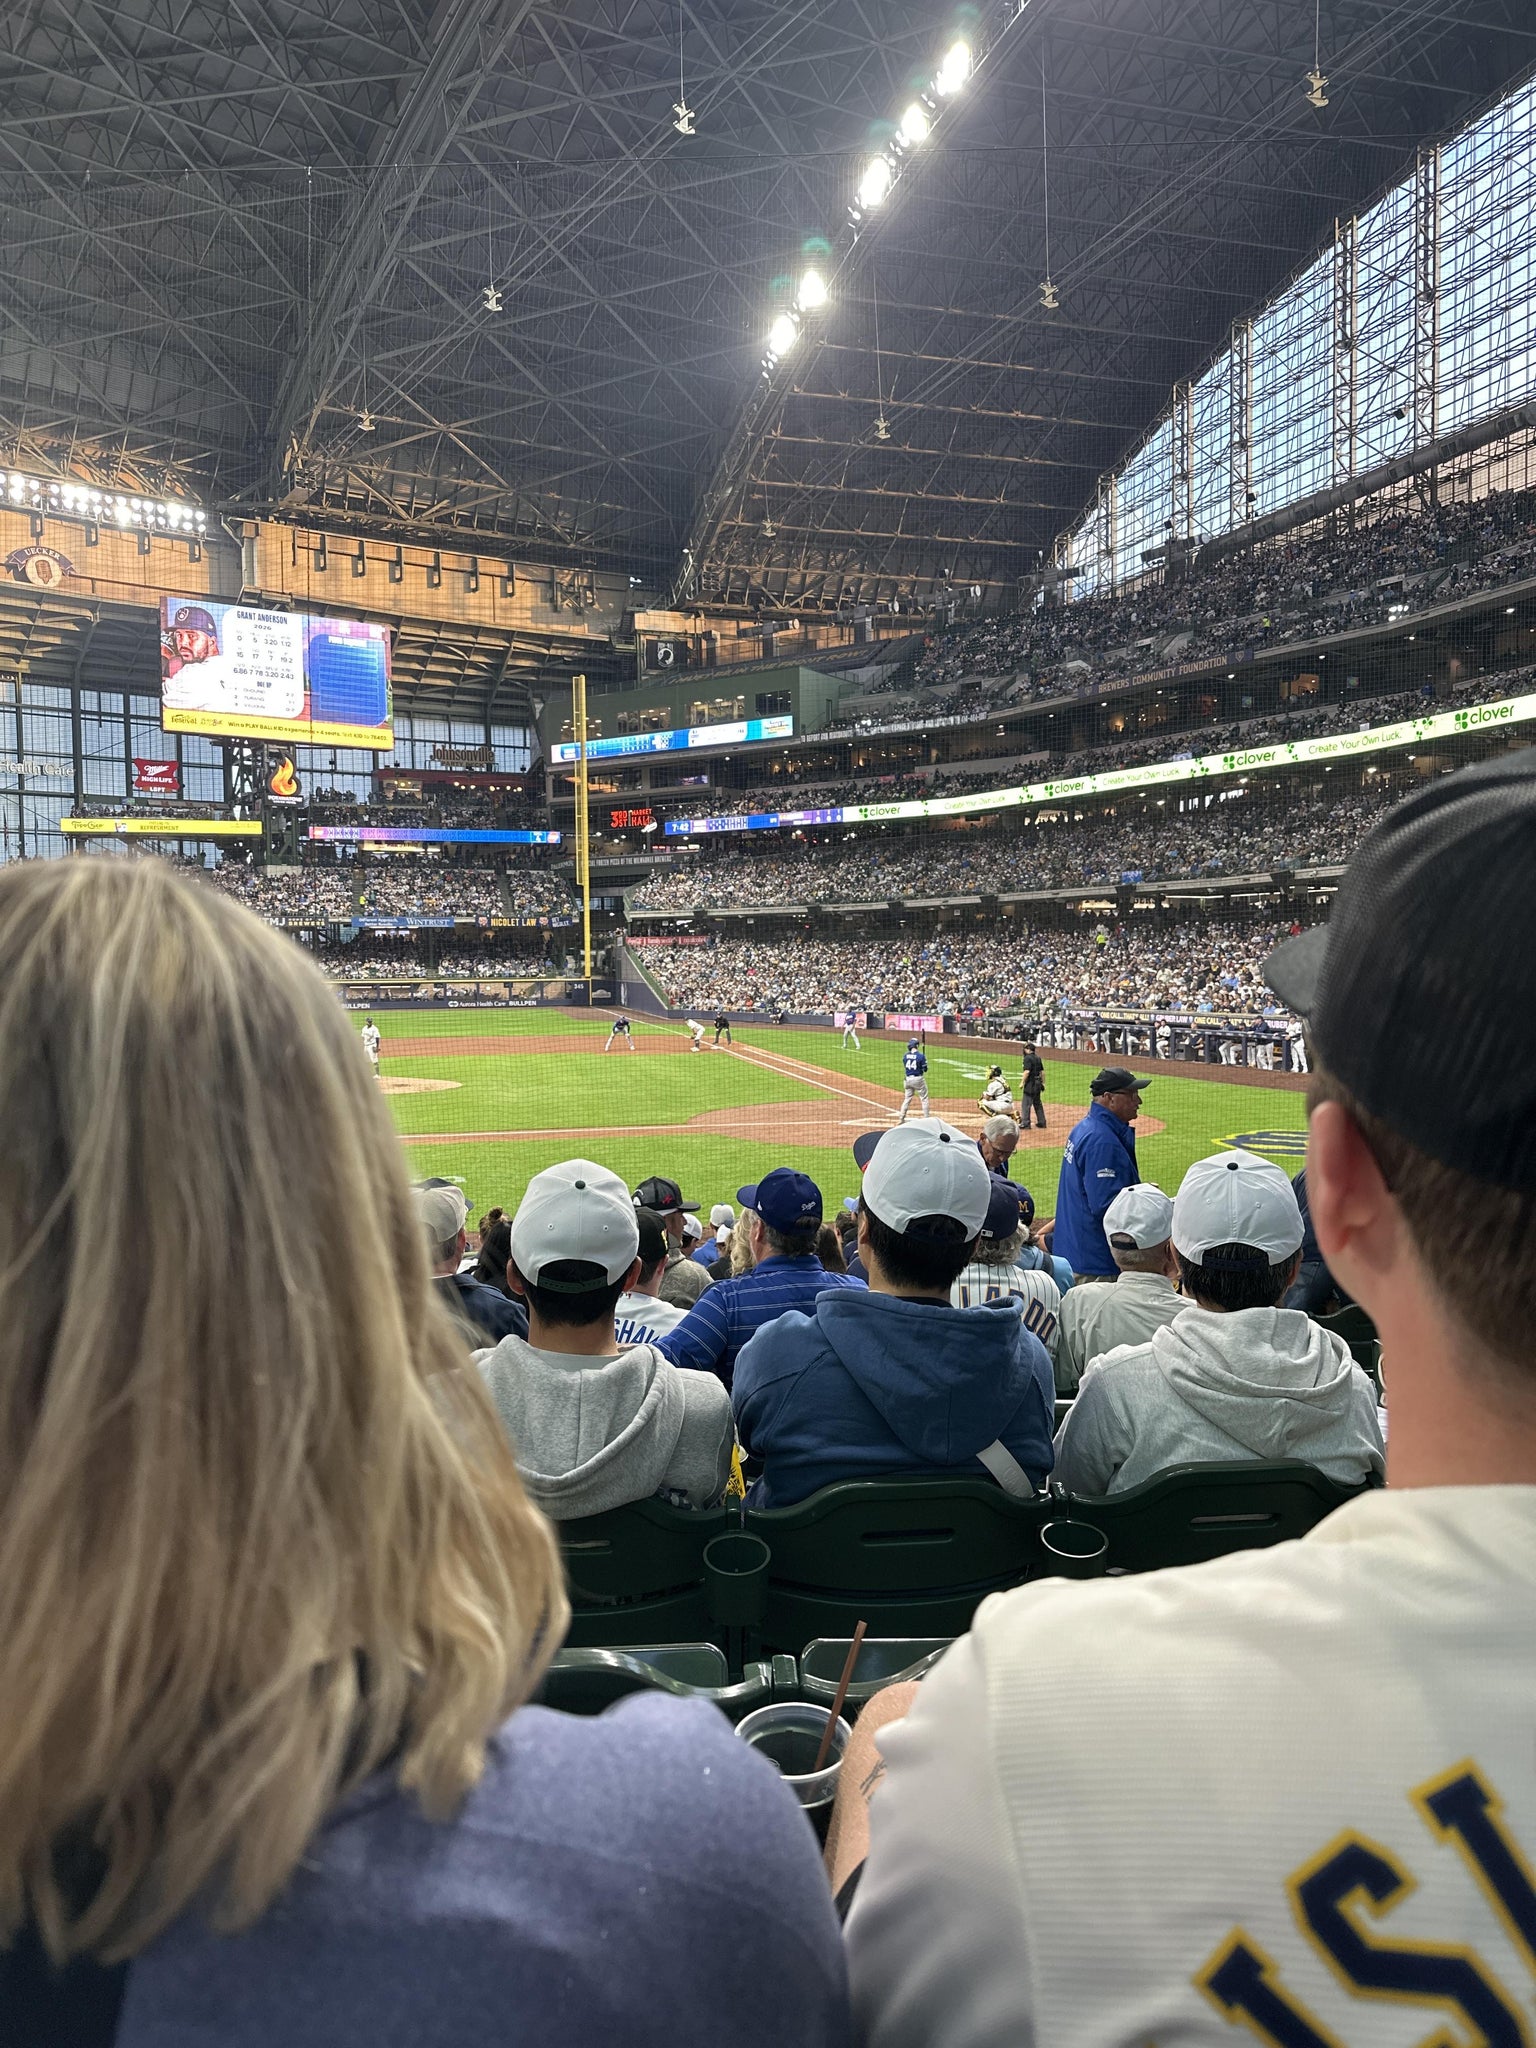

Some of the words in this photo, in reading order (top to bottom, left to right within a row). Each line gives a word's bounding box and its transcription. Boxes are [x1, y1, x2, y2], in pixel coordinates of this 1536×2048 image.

[24, 547, 60, 560] UECKER
[236, 610, 256, 620] GRANT
[258, 614, 288, 624] ANDERSON
[1099, 678, 1129, 693] BREWERS
[1132, 669, 1176, 686] COMMUNITY
[1179, 656, 1227, 674] FOUNDATION
[1470, 705, 1514, 724] clover
[1308, 742, 1337, 754] Create
[1341, 739, 1360, 750] Your
[1362, 736, 1380, 746] Own
[430, 744, 495, 762] Johnsonville
[1236, 751, 1276, 766] clover
[43, 763, 75, 777] Care
[1103, 776, 1124, 786] Create
[1126, 774, 1142, 782] Your
[1144, 771, 1160, 780] Own
[1054, 782, 1085, 794] clover
[870, 806, 900, 816] clover
[672, 823, 689, 832] 7:42
[406, 918, 449, 926] WINTRUST
[491, 918, 519, 926] NICOLET
[522, 918, 536, 926] LAW
[906, 1060, 917, 1070] 44
[1018, 1200, 1029, 1213] M
